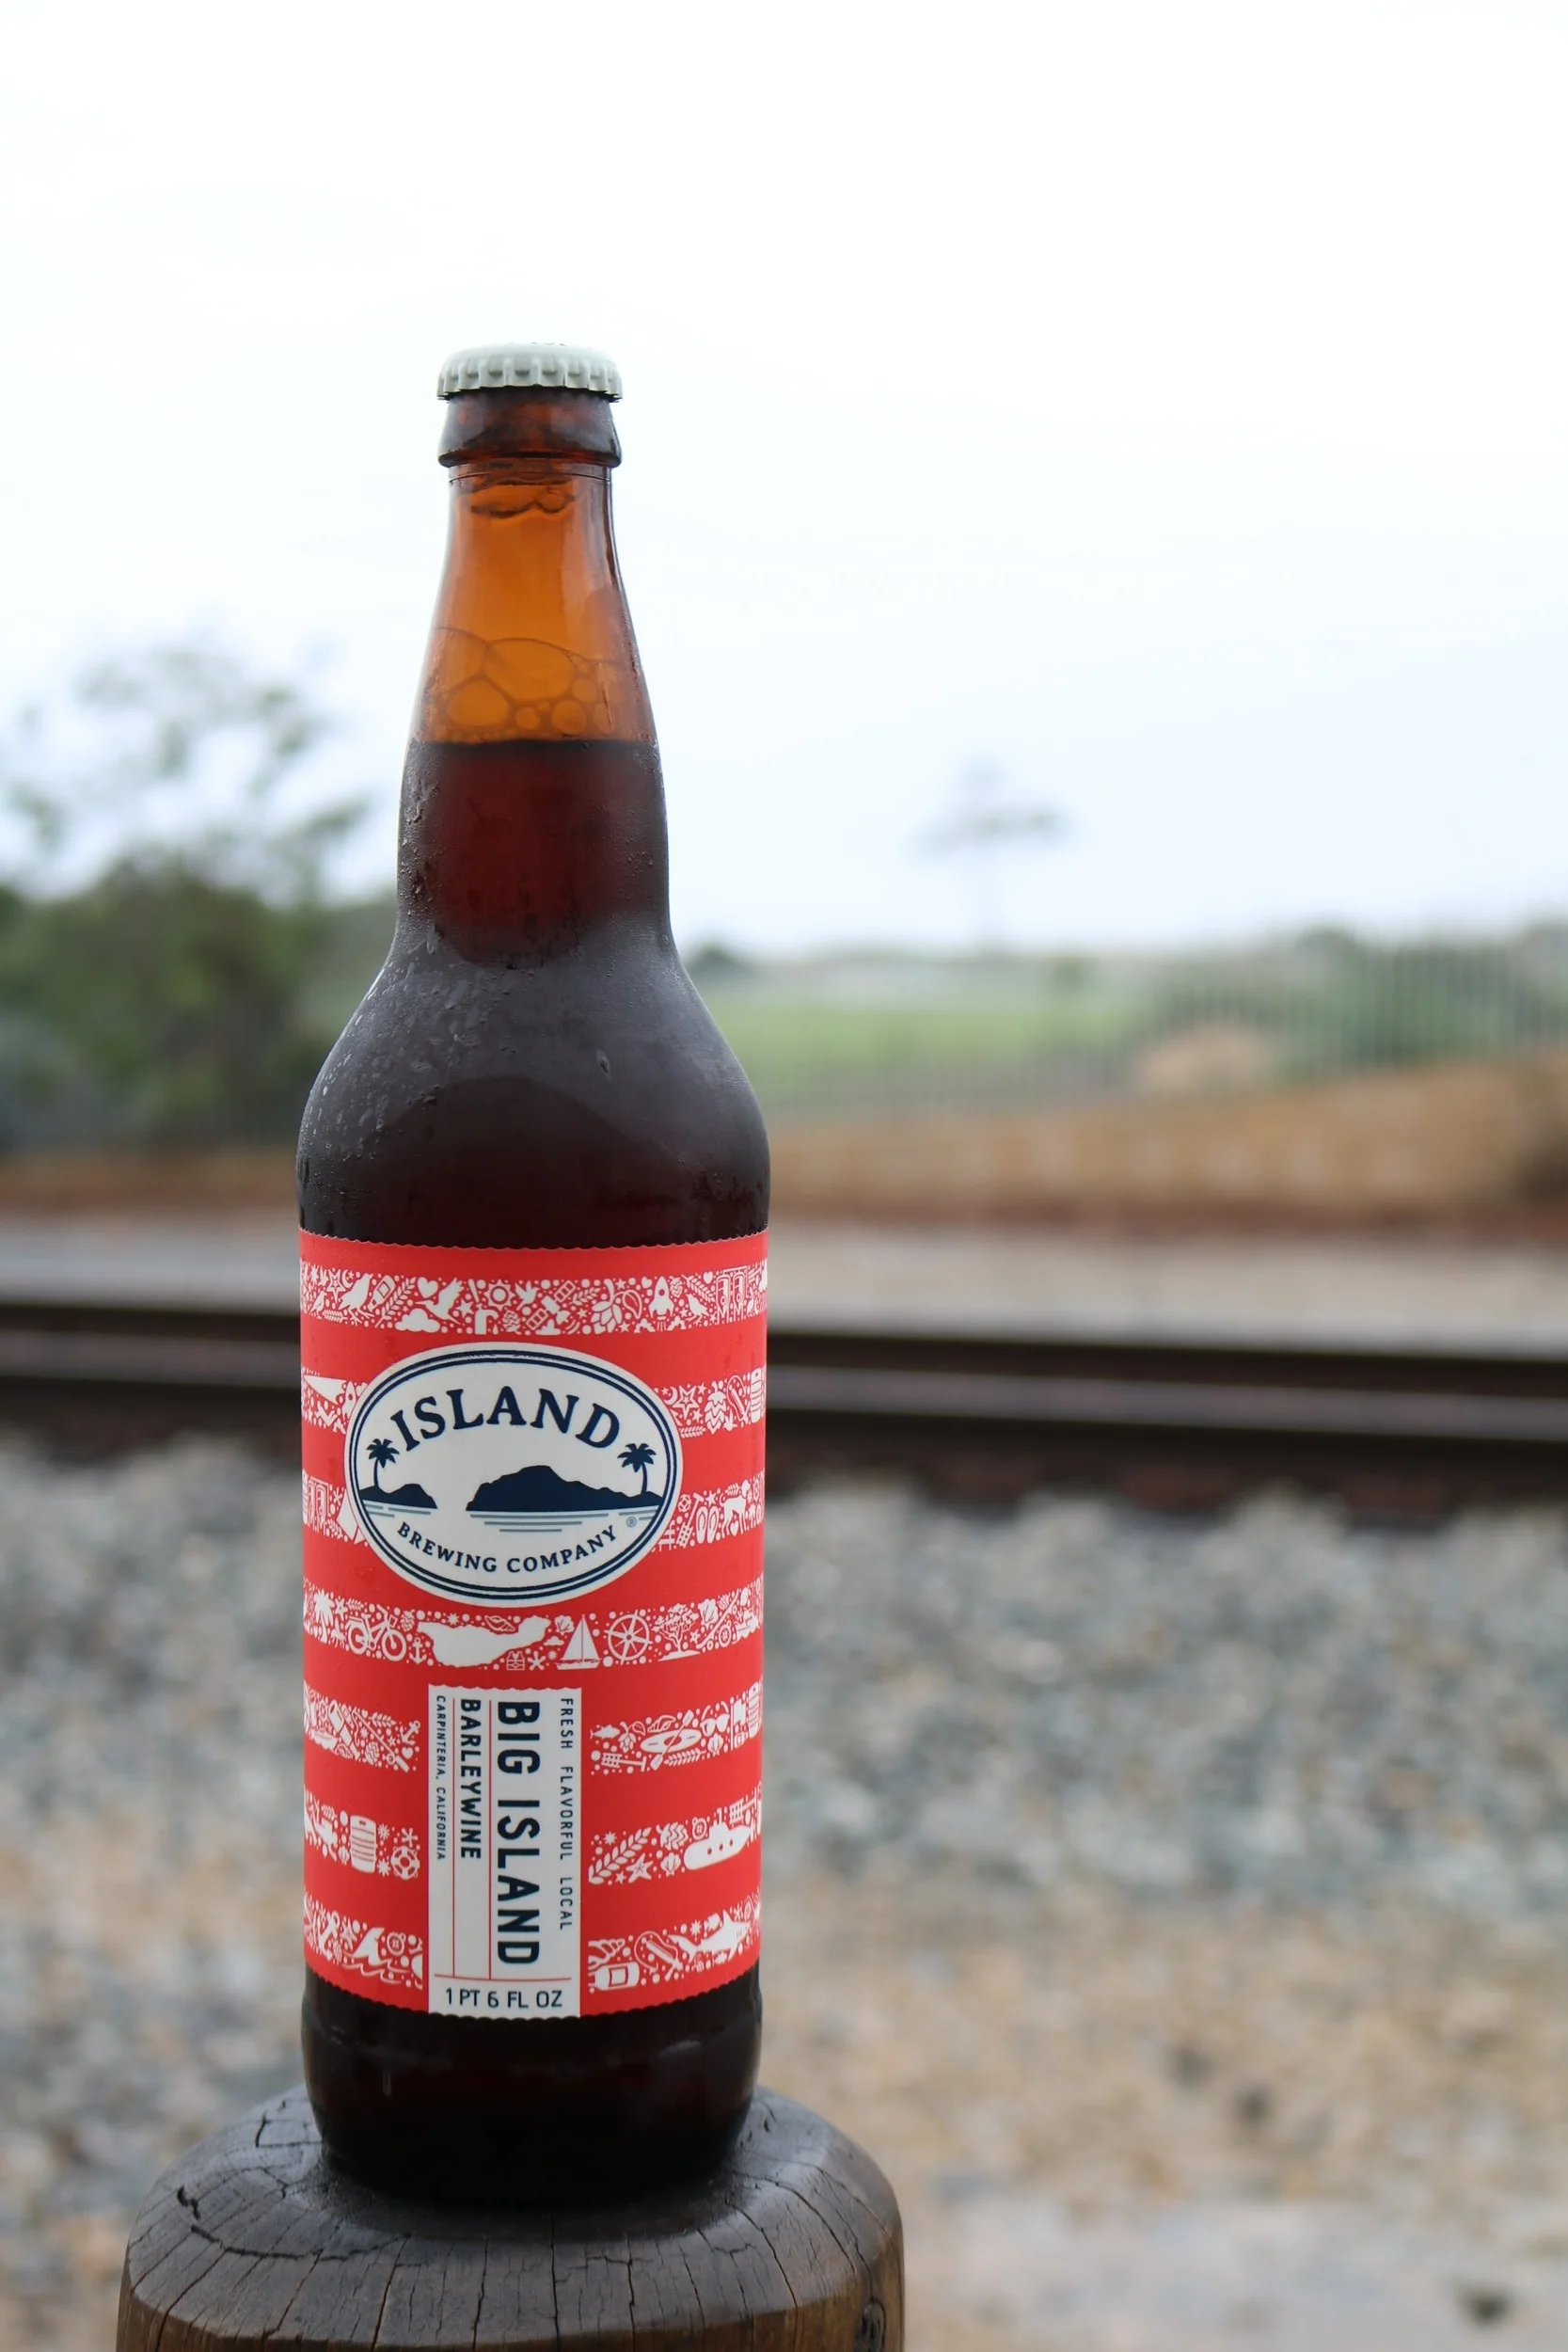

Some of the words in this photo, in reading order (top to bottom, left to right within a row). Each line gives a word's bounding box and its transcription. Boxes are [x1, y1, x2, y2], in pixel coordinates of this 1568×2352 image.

[389, 1385, 621, 1453] ISLAND
[396, 1521, 498, 1574] BREWING
[506, 1524, 618, 1574] COMPANY
[435, 1694, 447, 1780] CARPINTERIA,
[497, 1701, 542, 1775] BIG
[560, 1697, 575, 1749] FRESH
[460, 1698, 483, 1860] BARLEYWINE
[560, 1766, 574, 1861] FLAVORFUL
[436, 1787, 447, 1860] CALIFORNIA
[497, 1799, 541, 1965] ISLAND
[559, 1877, 574, 1931] LOCAL
[445, 1987, 452, 2006] 1
[459, 1988, 482, 2008] PT
[486, 1990, 499, 2010] 6
[507, 1990, 530, 2010] FL
[535, 1989, 563, 2010] OZ
